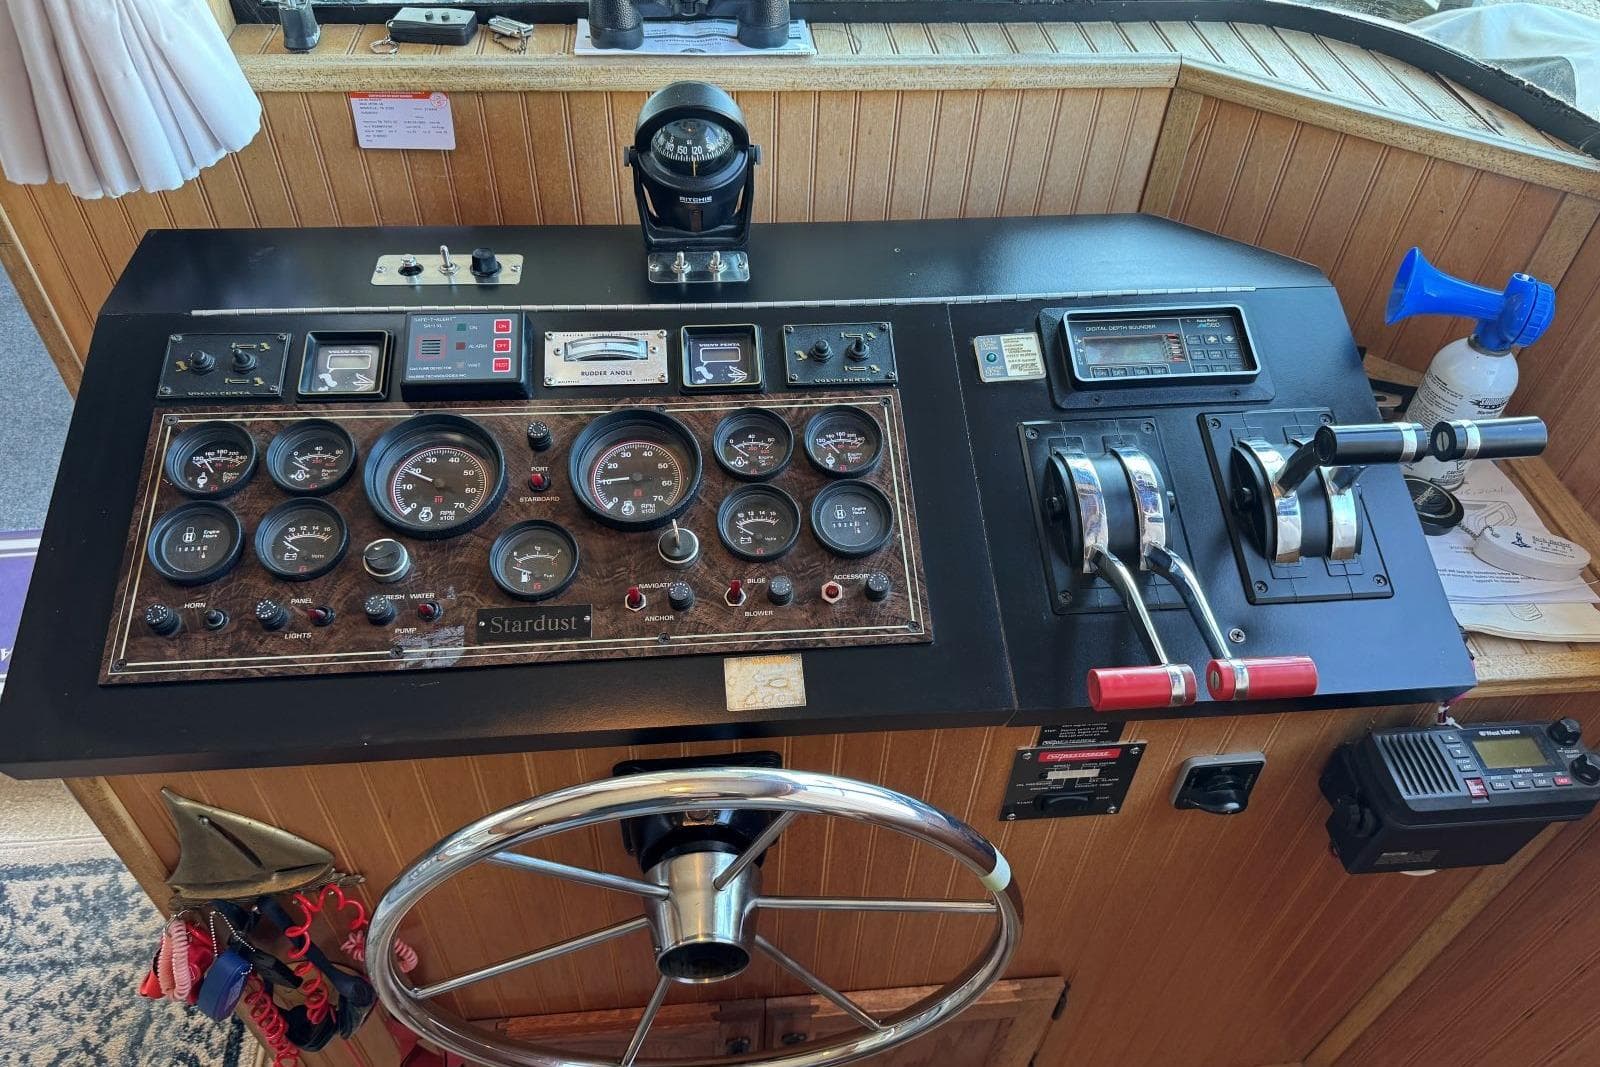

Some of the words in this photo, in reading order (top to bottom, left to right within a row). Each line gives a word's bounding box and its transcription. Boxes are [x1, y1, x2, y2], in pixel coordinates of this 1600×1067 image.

[677, 146, 688, 155] 150
[691, 146, 702, 155] 120
[706, 144, 715, 152] 90
[679, 195, 713, 203] RITCHIE
[661, 479, 673, 487] 60
[489, 614, 578, 634] Stardust
[284, 632, 312, 640] LIGHTS
